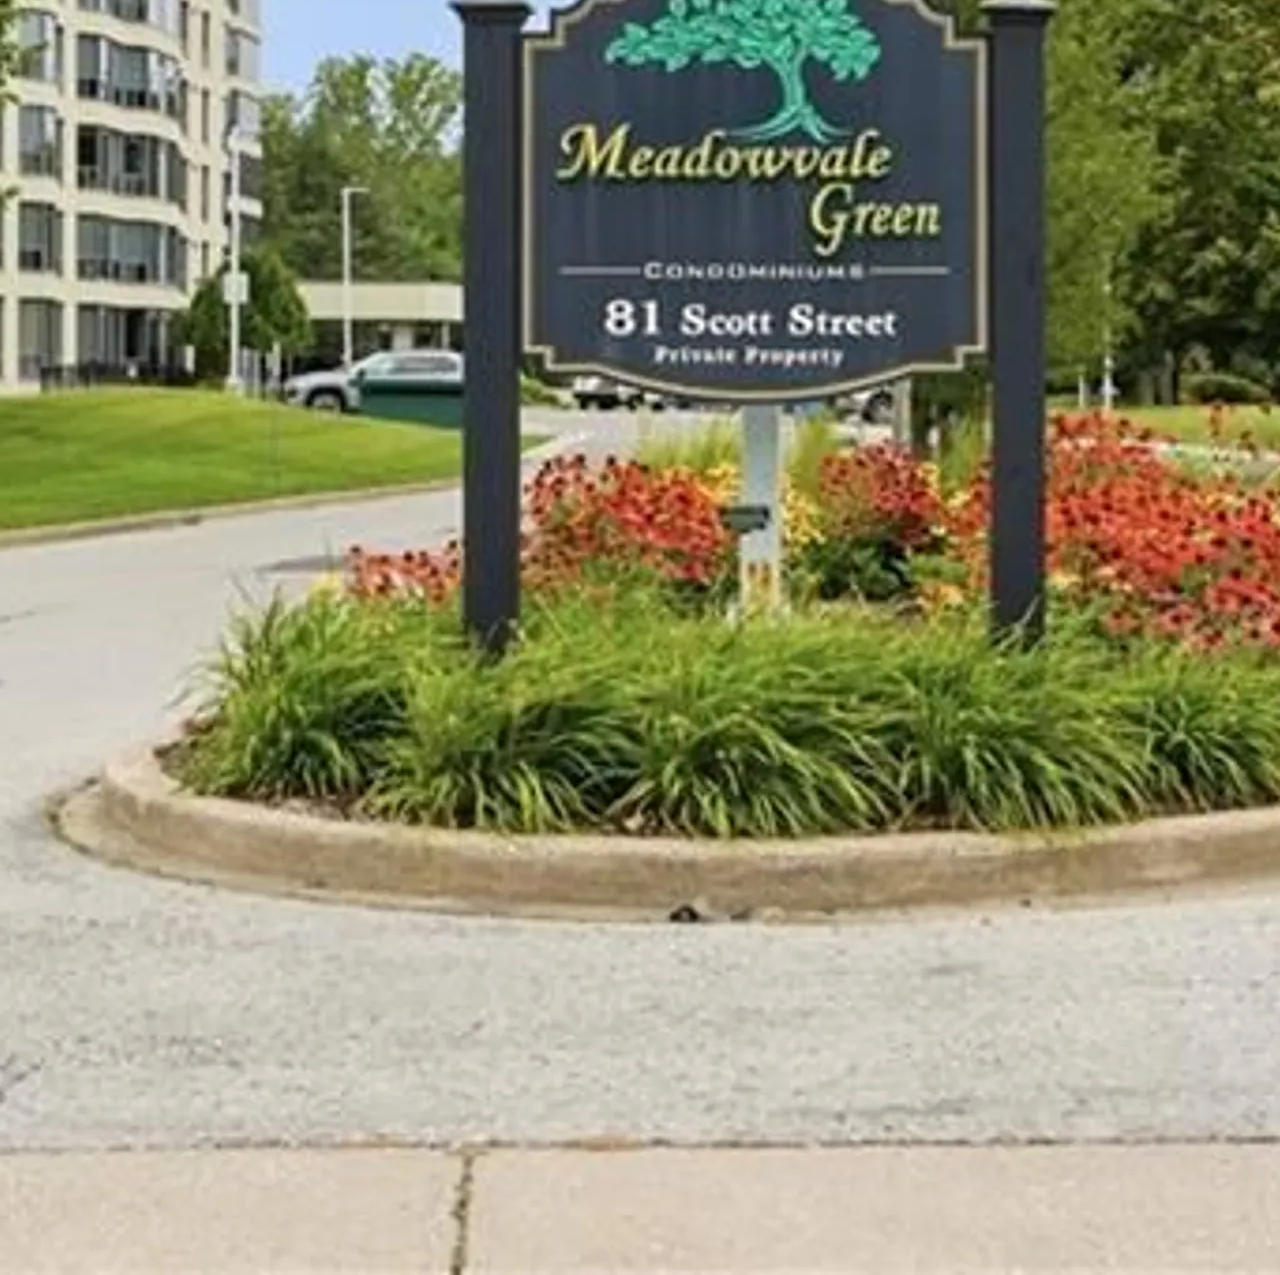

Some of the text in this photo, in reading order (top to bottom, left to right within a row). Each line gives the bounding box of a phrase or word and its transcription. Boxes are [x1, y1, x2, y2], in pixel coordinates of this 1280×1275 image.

[556, 123, 893, 181] Meadowvale
[810, 183, 941, 257] Green
[644, 261, 867, 281] CONDOMINIUMS
[605, 300, 898, 338] 81 Scott Street
[654, 346, 844, 368] Private Property
